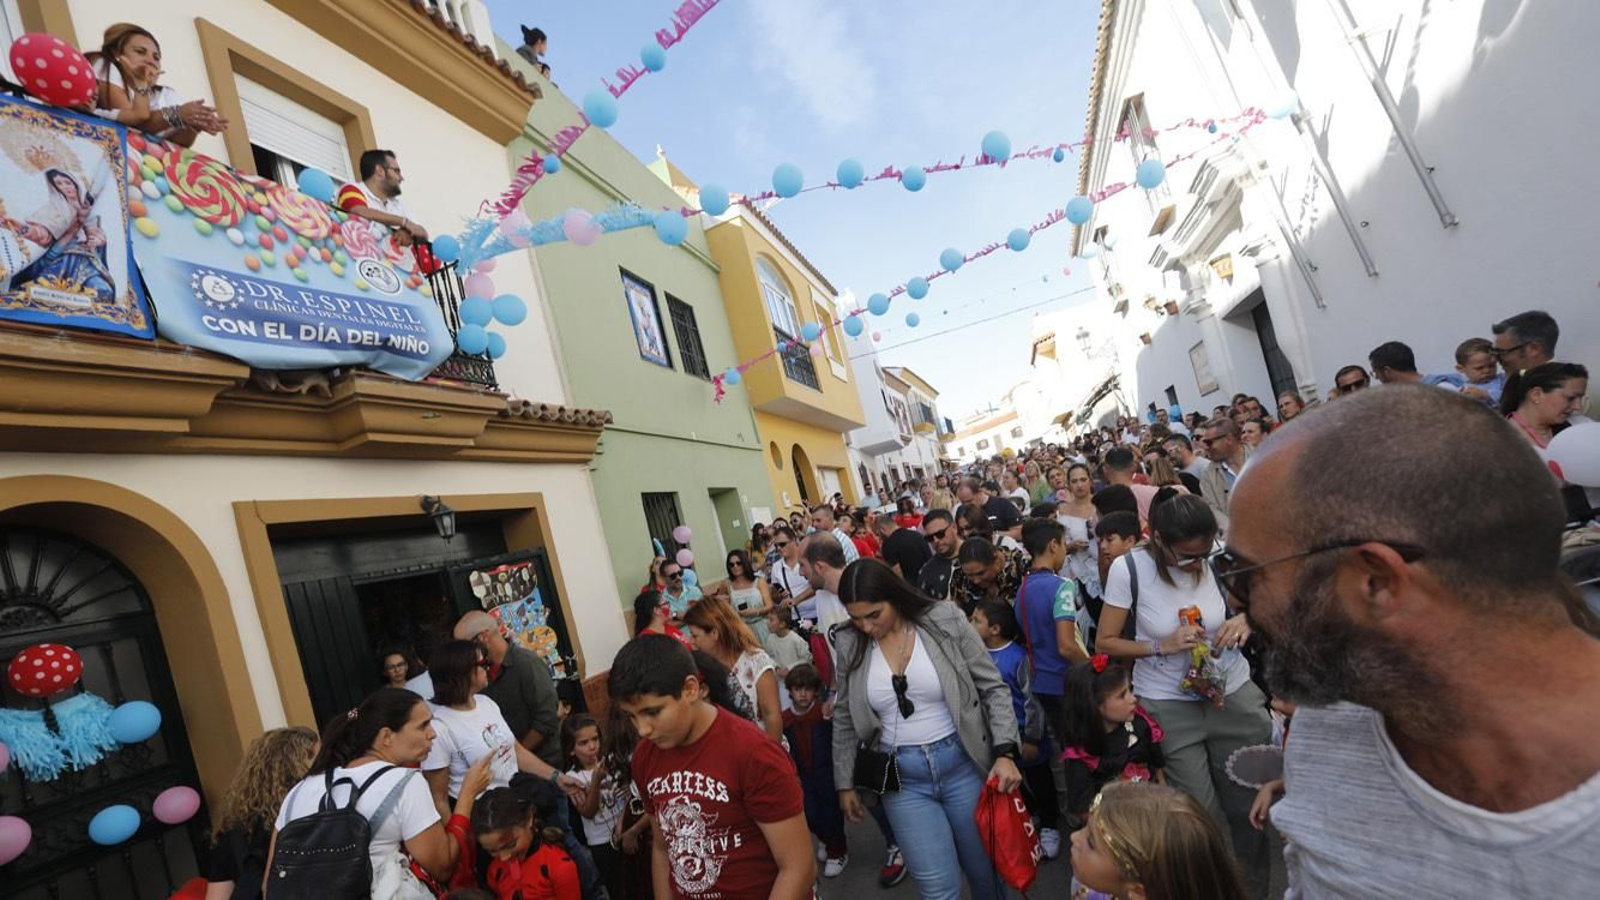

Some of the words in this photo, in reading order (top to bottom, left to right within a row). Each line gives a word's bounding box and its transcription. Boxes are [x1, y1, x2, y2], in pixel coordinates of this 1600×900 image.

[241, 279, 299, 305] DR.
[297, 290, 421, 324] ESPINEL
[202, 314, 258, 337] CON
[263, 321, 293, 340] EL
[300, 322, 342, 344] DÍA
[346, 328, 384, 347] DEL
[386, 333, 430, 355] NIÑO
[1060, 590, 1075, 611] 3
